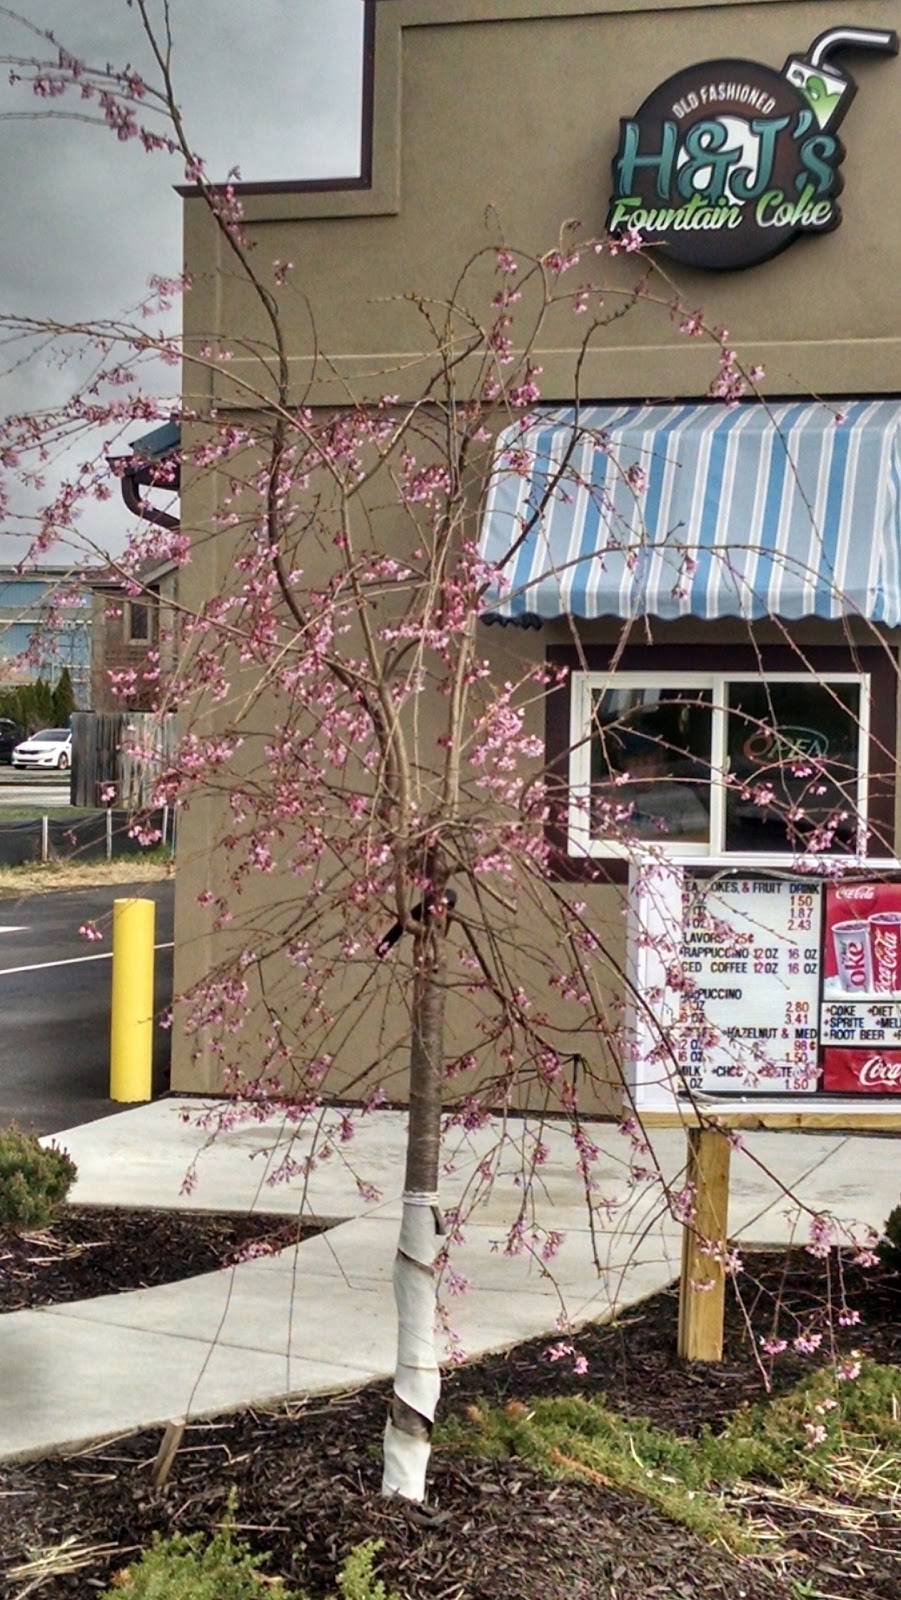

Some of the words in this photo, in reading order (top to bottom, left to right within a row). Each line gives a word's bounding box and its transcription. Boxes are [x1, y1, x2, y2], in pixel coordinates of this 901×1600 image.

[671, 91, 699, 119] OLD
[701, 81, 777, 115] FASHIONED
[616, 109, 838, 202] H&J's
[610, 192, 743, 231] Fountain
[755, 184, 832, 228] Coke
[741, 882, 750, 893] &
[752, 883, 782, 893] FRUIT
[790, 908, 814, 918] 1.87
[787, 920, 812, 931] 2.43
[682, 932, 725, 944] LAVORS
[787, 948, 800, 960] 16
[804, 948, 817, 960] OZ
[710, 962, 748, 973] COFFEE
[787, 962, 800, 974] 16
[803, 963, 817, 974] OZ
[786, 1001, 810, 1013] 2.80
[830, 1005, 856, 1016] COKE
[871, 1005, 894, 1016] DIET
[784, 1013, 808, 1025] 3.41
[830, 1017, 864, 1028] SPRITE
[781, 1028, 789, 1039] &
[829, 1029, 856, 1040] ROOT
[860, 1029, 885, 1040] BEER
[690, 1078, 703, 1089] OZ
[785, 1079, 809, 1090] 1.50
